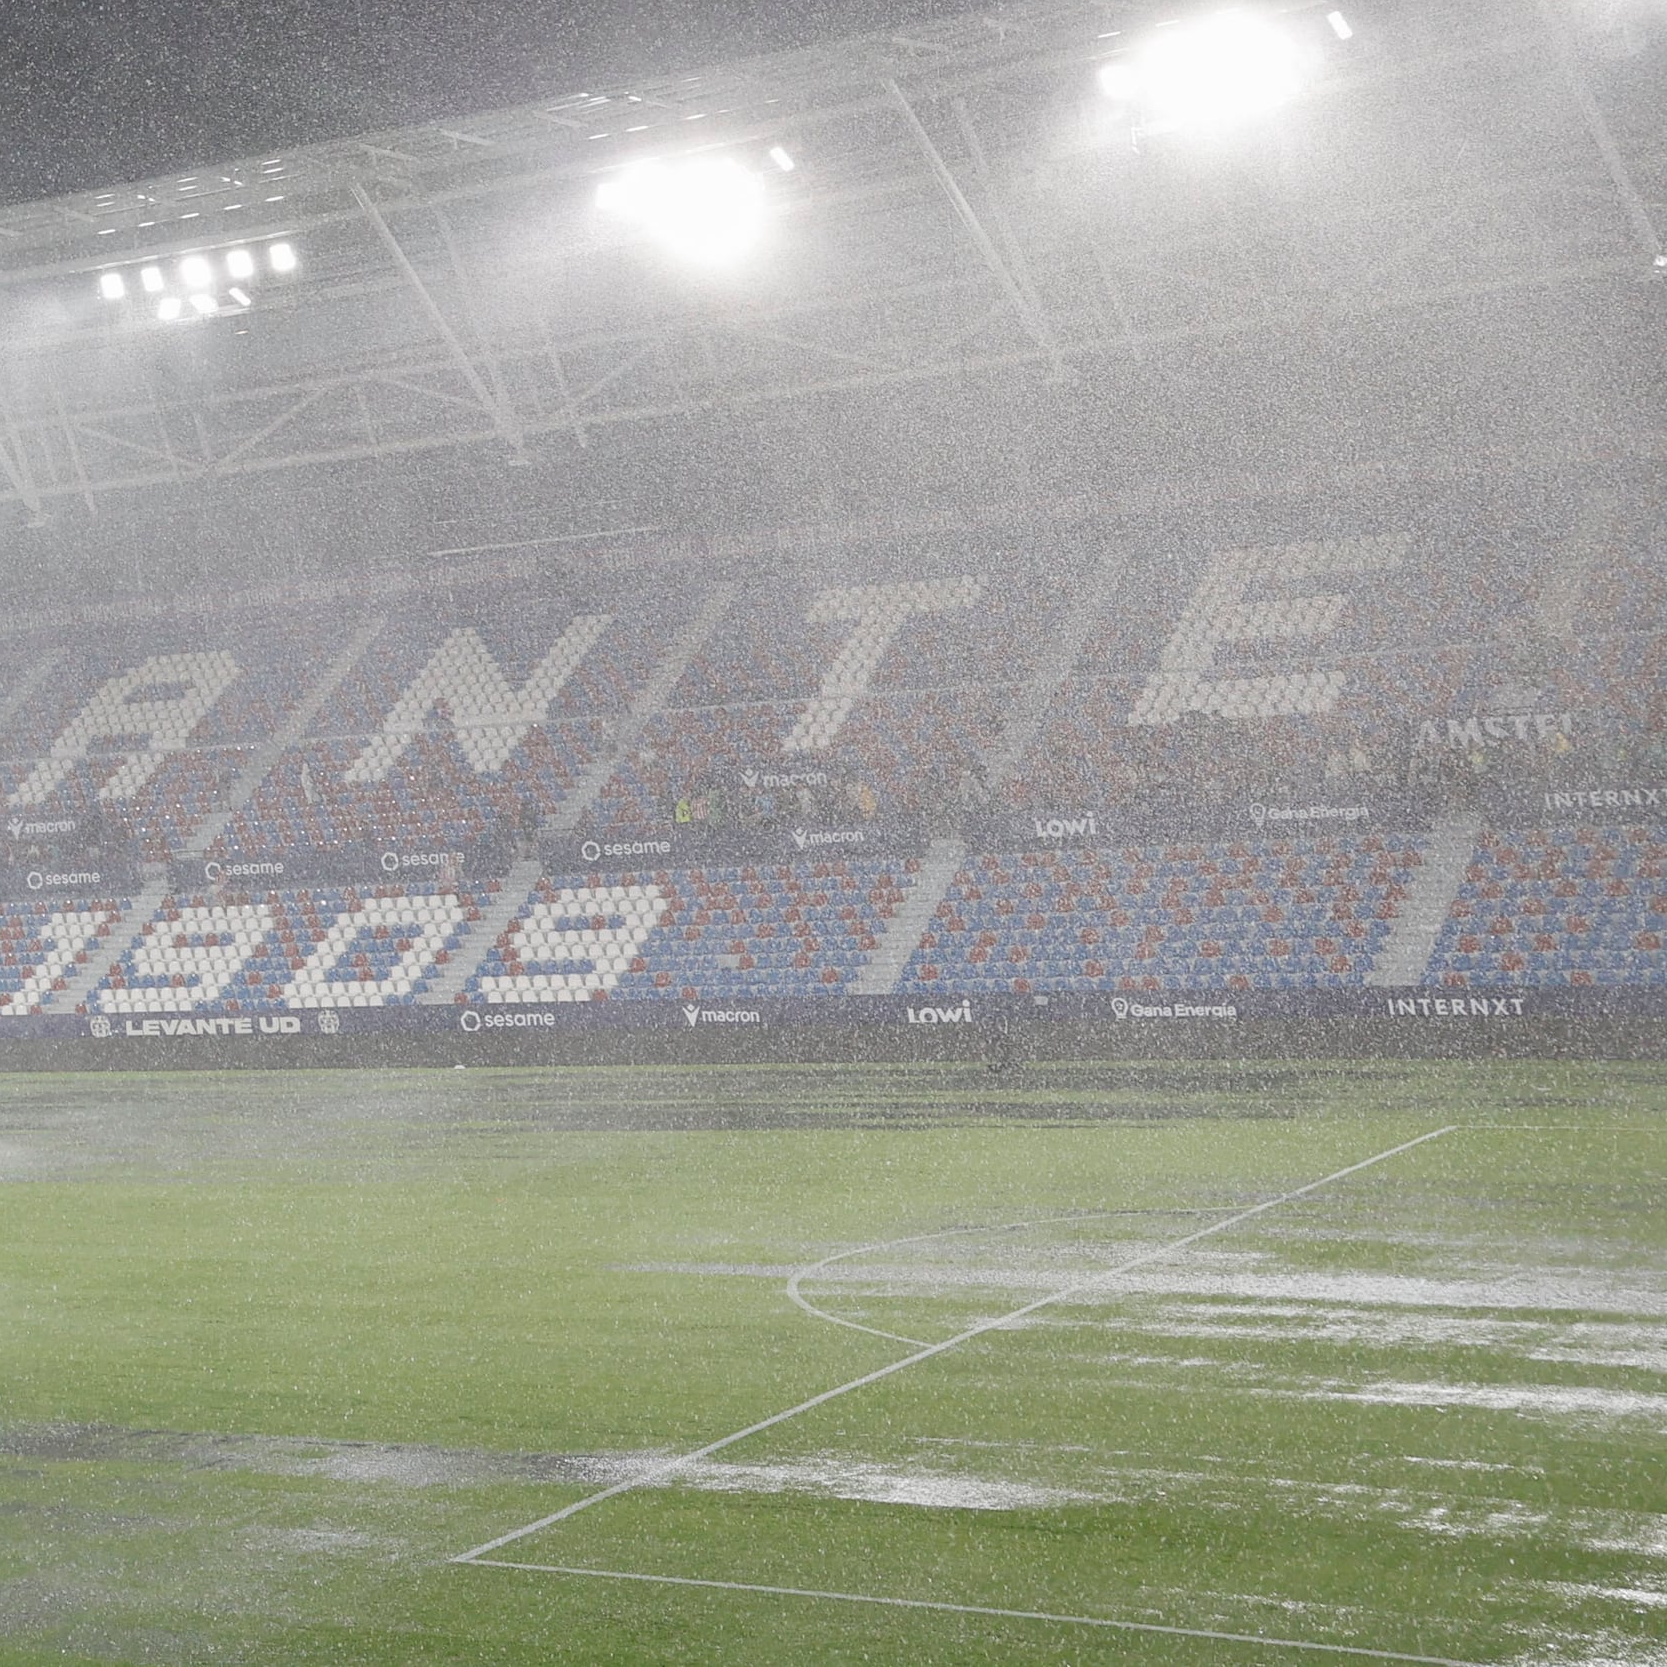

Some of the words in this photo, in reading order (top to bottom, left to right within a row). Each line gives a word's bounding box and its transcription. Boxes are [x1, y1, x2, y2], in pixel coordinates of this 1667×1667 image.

[25, 820, 76, 834] macron
[809, 828, 863, 844] macron
[604, 840, 671, 856] sesame
[226, 860, 285, 875] sesame
[45, 871, 101, 886] sesame
[1, 884, 668, 1016] 1909
[1131, 1003, 1173, 1018] Gana
[1387, 997, 1525, 1017] INTERNXT
[484, 1011, 556, 1027] sesame
[701, 1009, 760, 1023] macron
[125, 1016, 253, 1036] LEVANTE
[259, 1016, 301, 1034] UD
